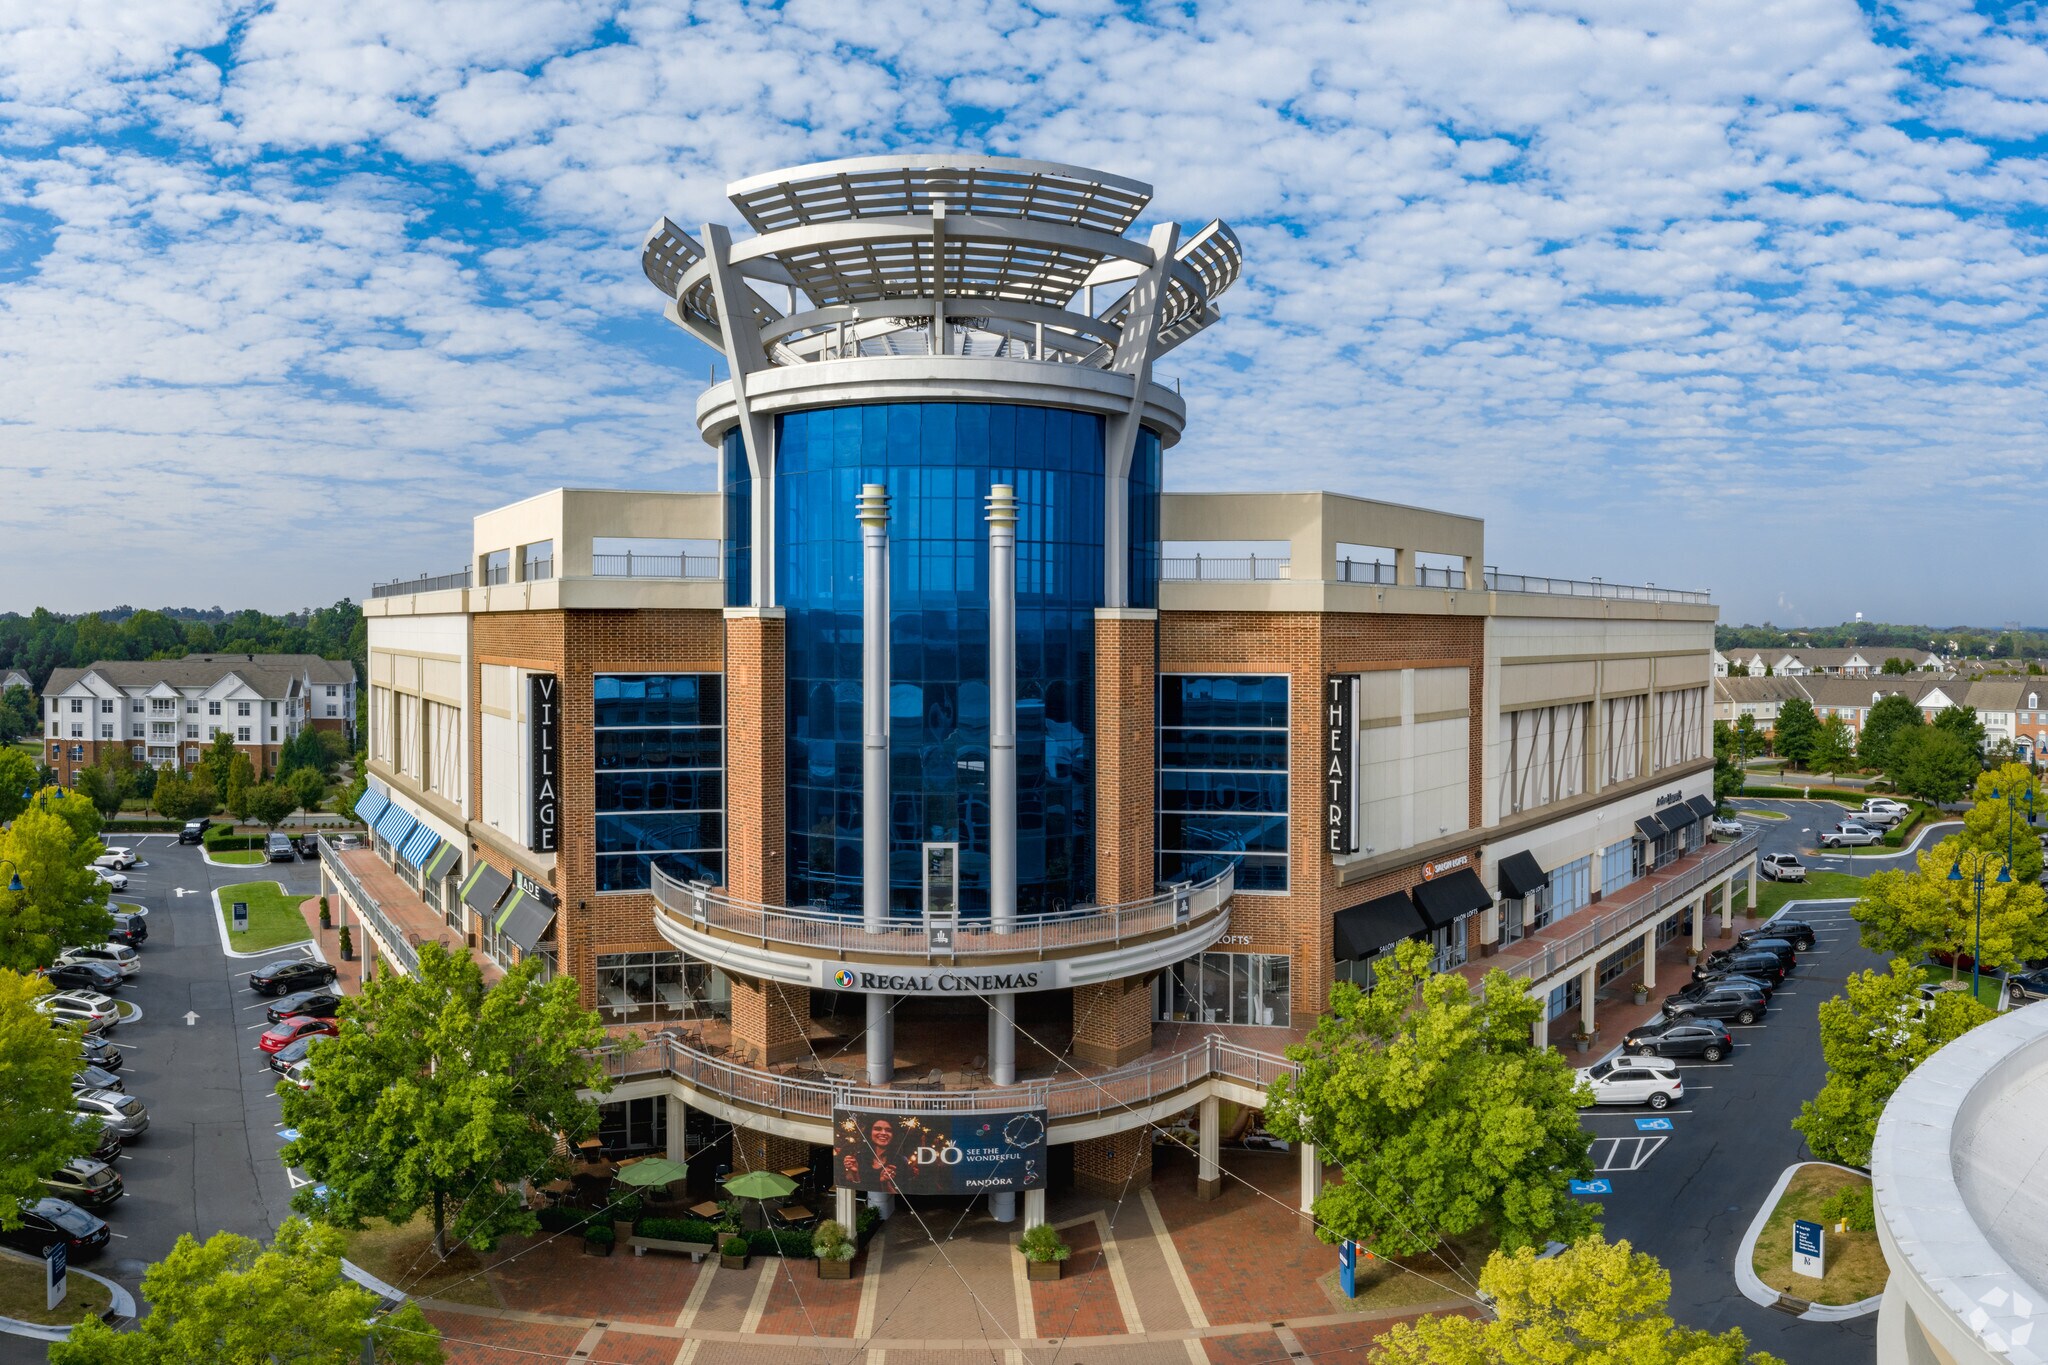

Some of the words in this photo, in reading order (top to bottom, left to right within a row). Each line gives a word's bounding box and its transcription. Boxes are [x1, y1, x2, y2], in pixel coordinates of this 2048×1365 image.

[539, 678, 555, 850] VILLAGE
[1328, 679, 1343, 851] THEATRE
[1434, 860, 1452, 874] SALON
[1452, 856, 1468, 868] LOFTS
[860, 972, 933, 991] REGAL
[938, 973, 1038, 991] CINEMAS
[966, 1153, 1020, 1162] WONDERFUL
